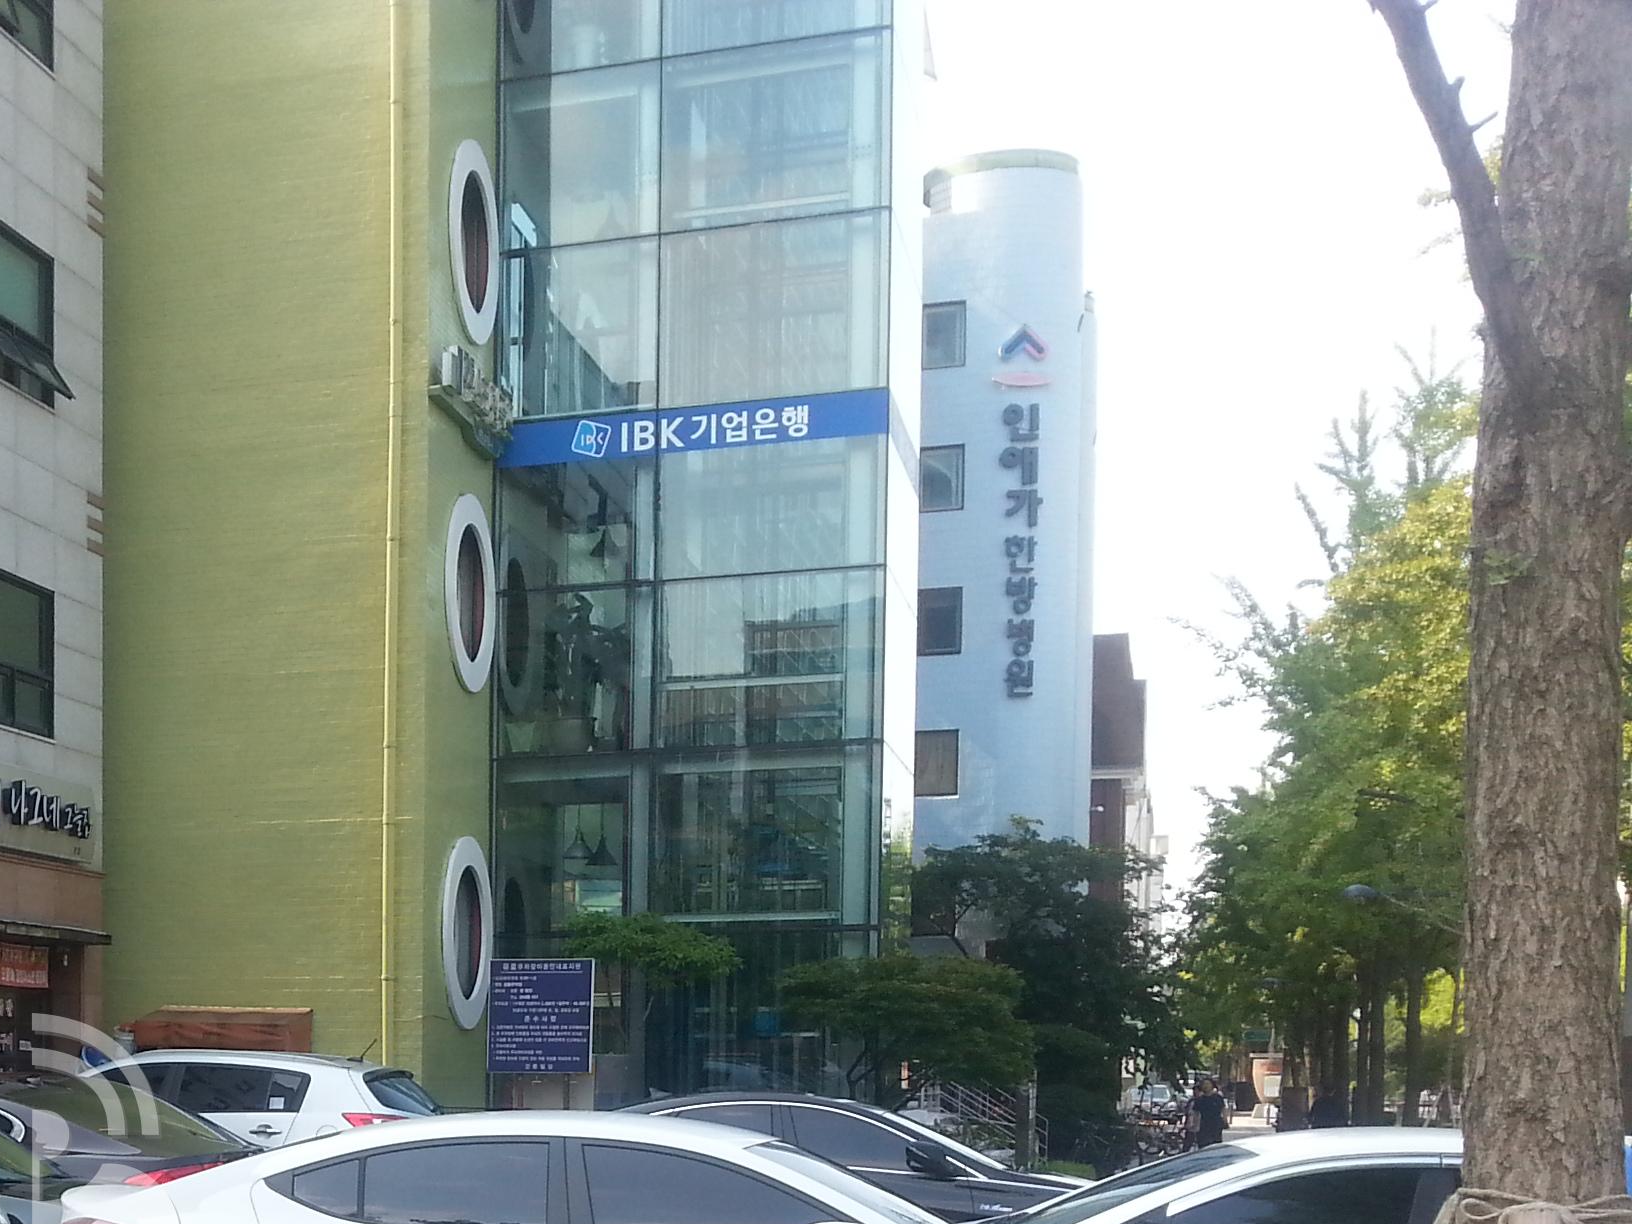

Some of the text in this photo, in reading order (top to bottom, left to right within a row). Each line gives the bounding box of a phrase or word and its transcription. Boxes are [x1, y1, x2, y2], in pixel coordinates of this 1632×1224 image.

[620, 404, 810, 454] IBK 기업은행
[1004, 534, 1039, 700] 한방병원
[9, 779, 61, 830] 나그네
